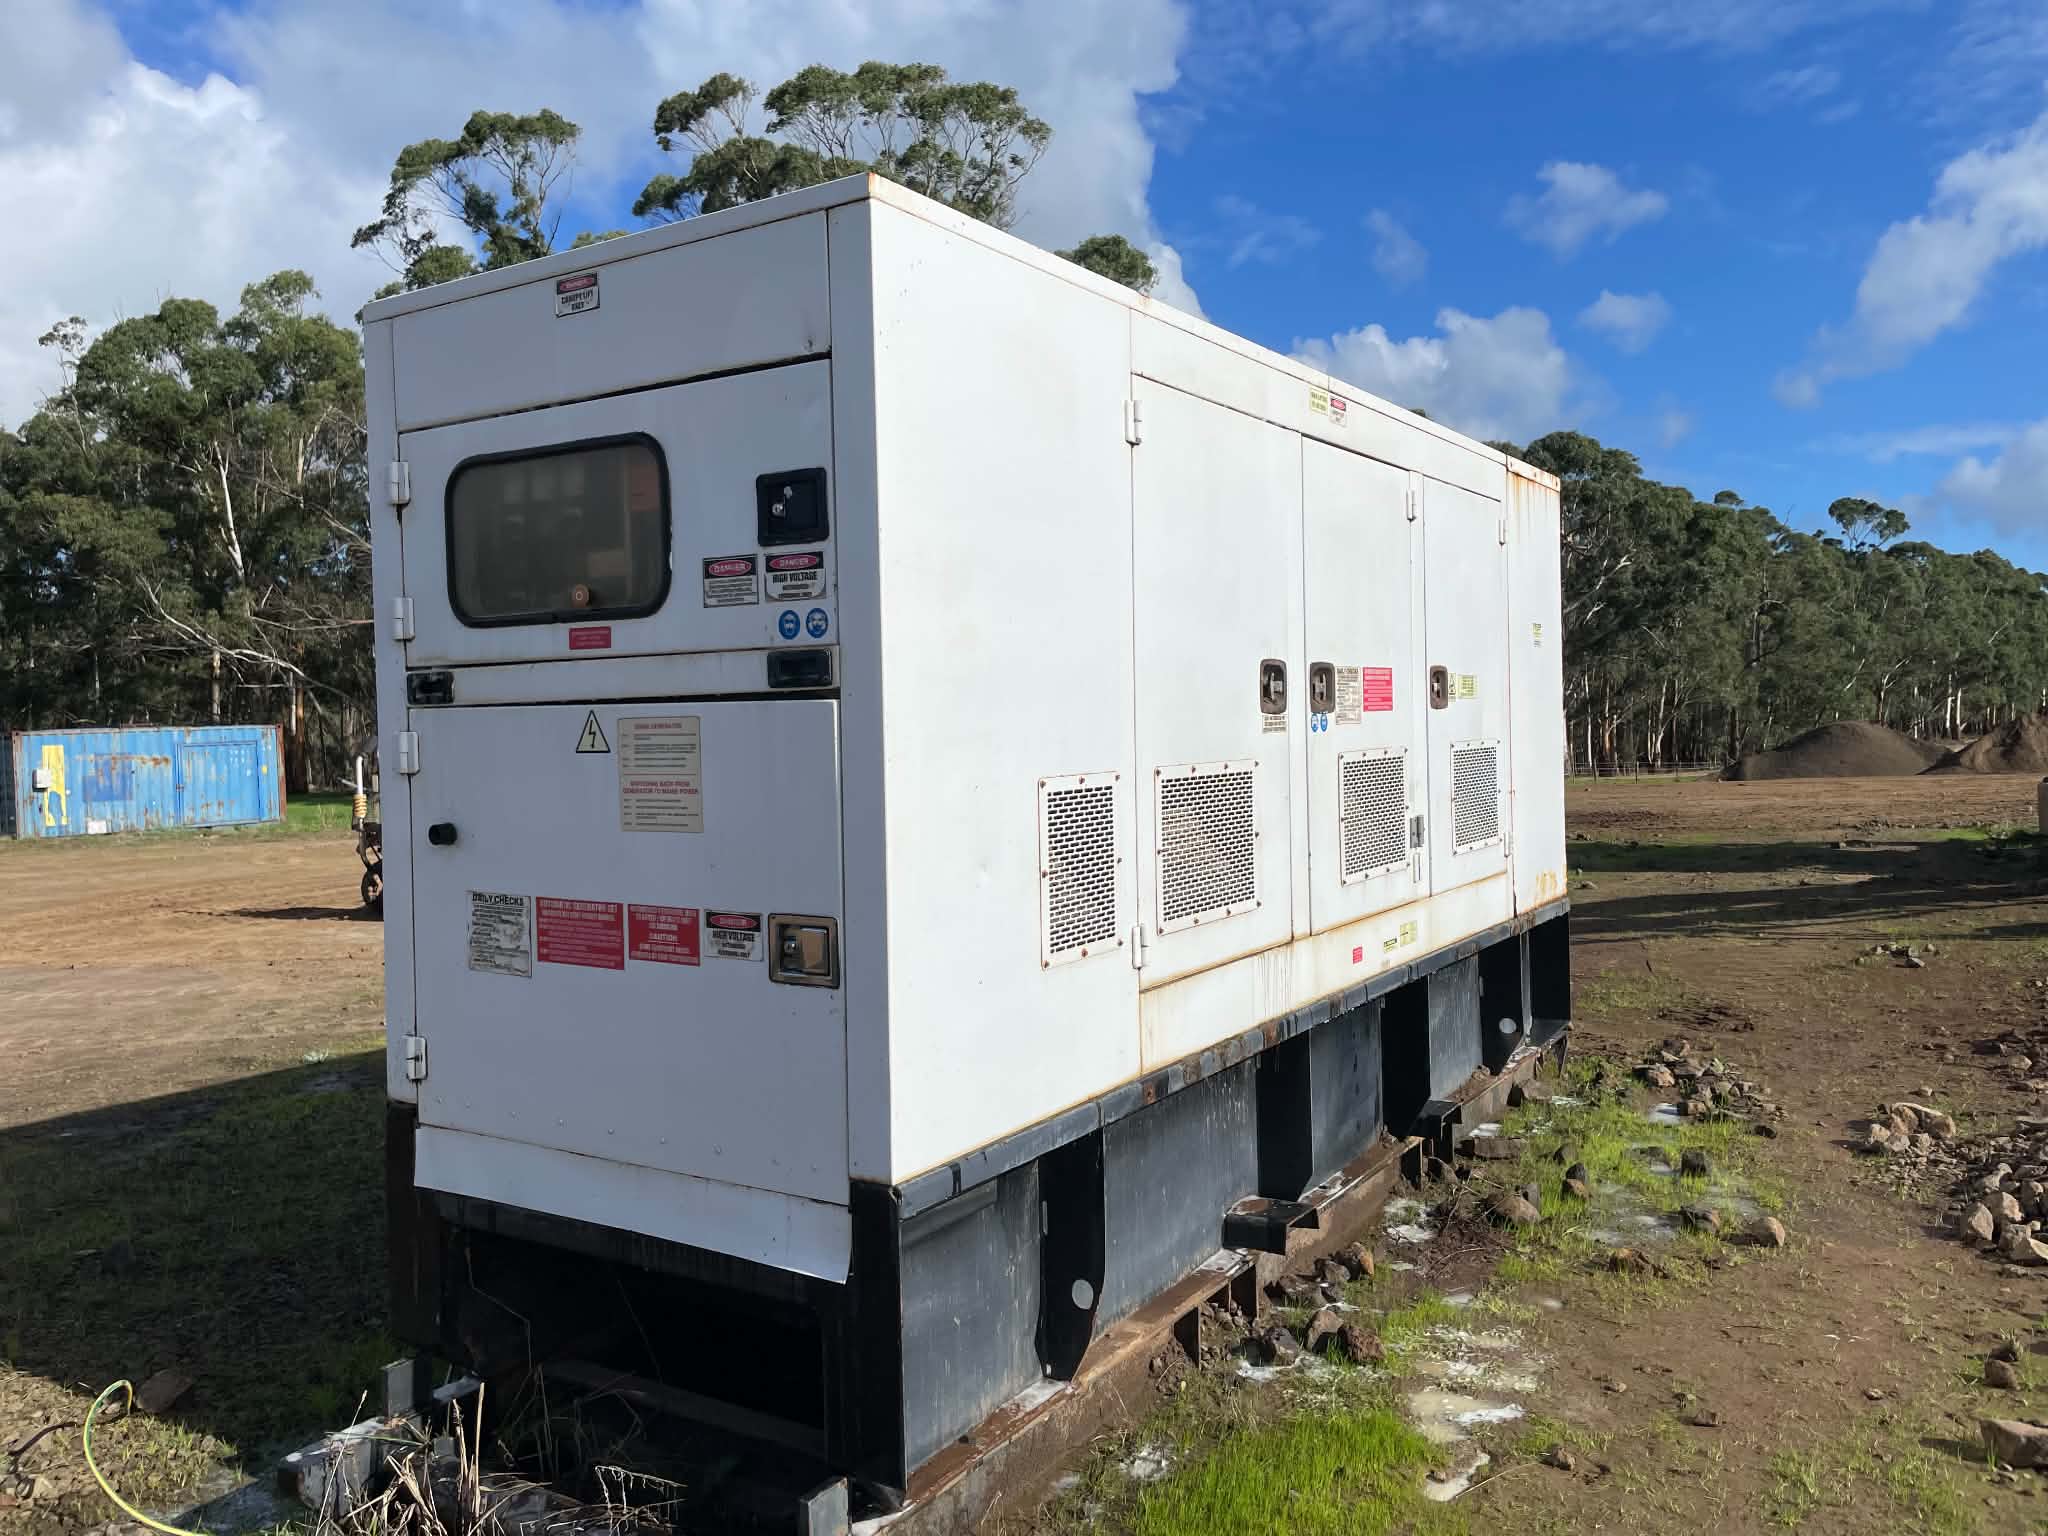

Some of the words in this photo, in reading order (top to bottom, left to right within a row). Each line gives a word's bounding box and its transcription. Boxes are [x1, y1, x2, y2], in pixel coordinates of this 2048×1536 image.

[780, 557, 809, 567] DANGER
[713, 563, 746, 573] DANGER
[772, 573, 788, 584] HIGH
[789, 571, 817, 582] VOLTAGE
[494, 894, 524, 906] CHECKS
[728, 931, 754, 942] VOLTAGE
